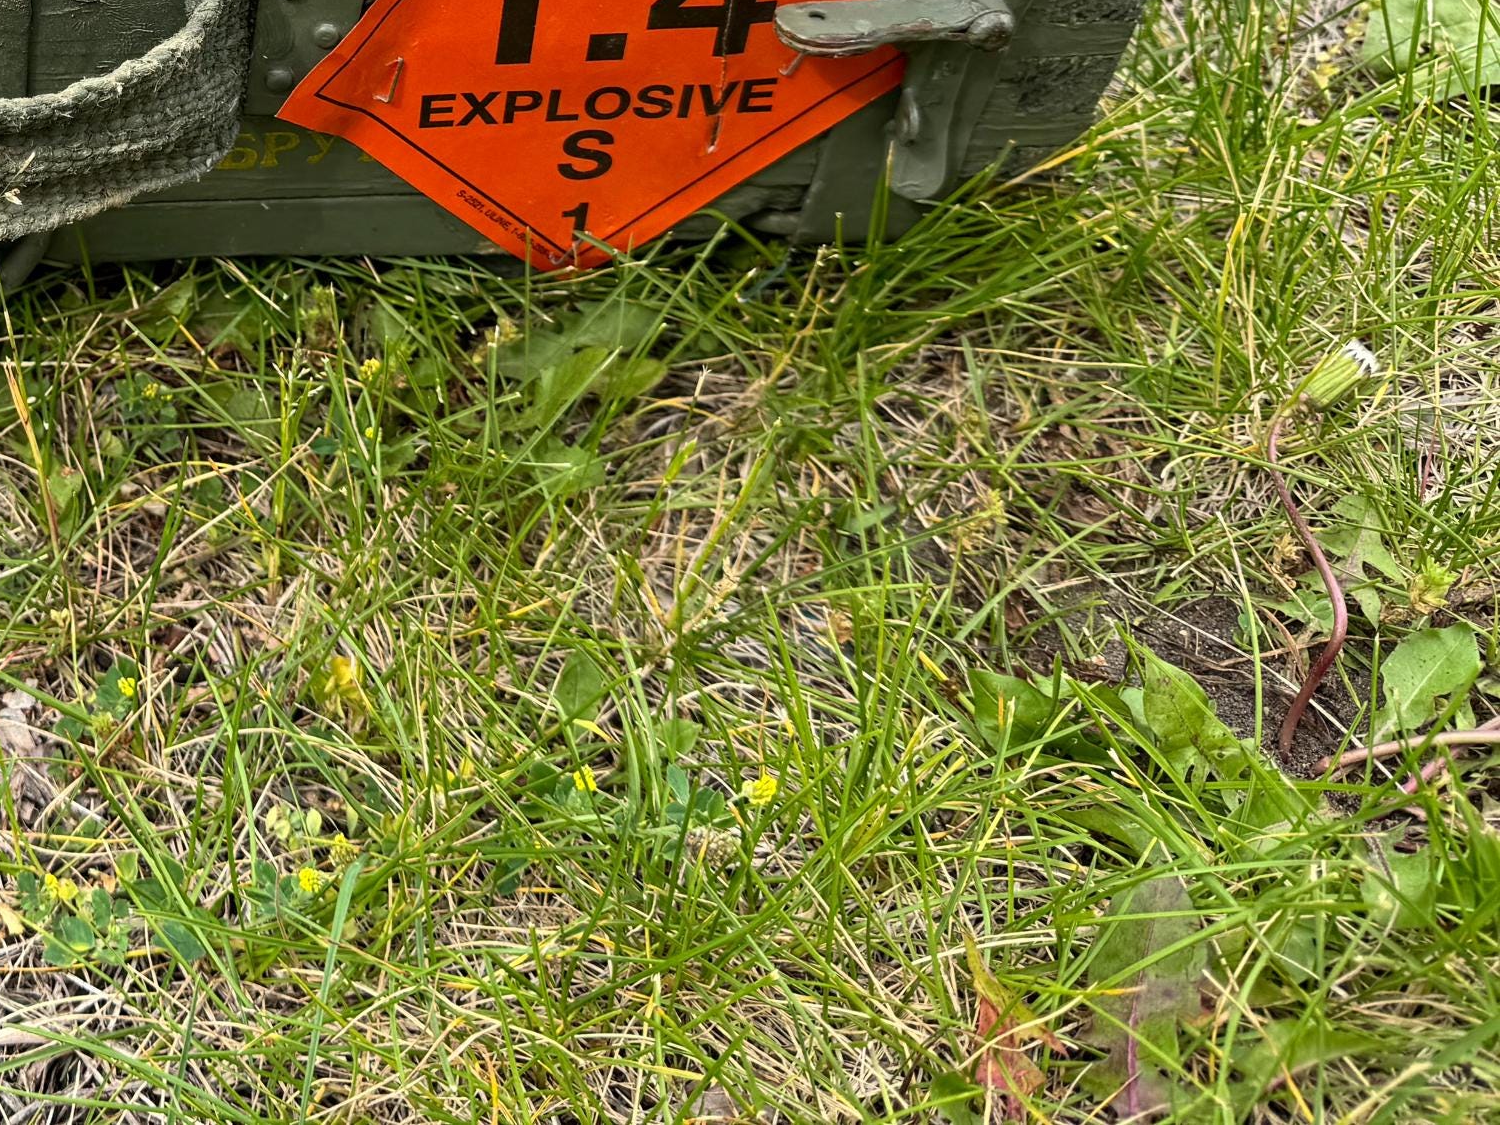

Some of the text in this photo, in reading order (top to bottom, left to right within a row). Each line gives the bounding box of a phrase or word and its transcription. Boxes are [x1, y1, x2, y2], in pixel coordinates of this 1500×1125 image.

[417, 76, 778, 130] EXPLOSIVE
[557, 129, 614, 180] S
[561, 201, 590, 243] 1
